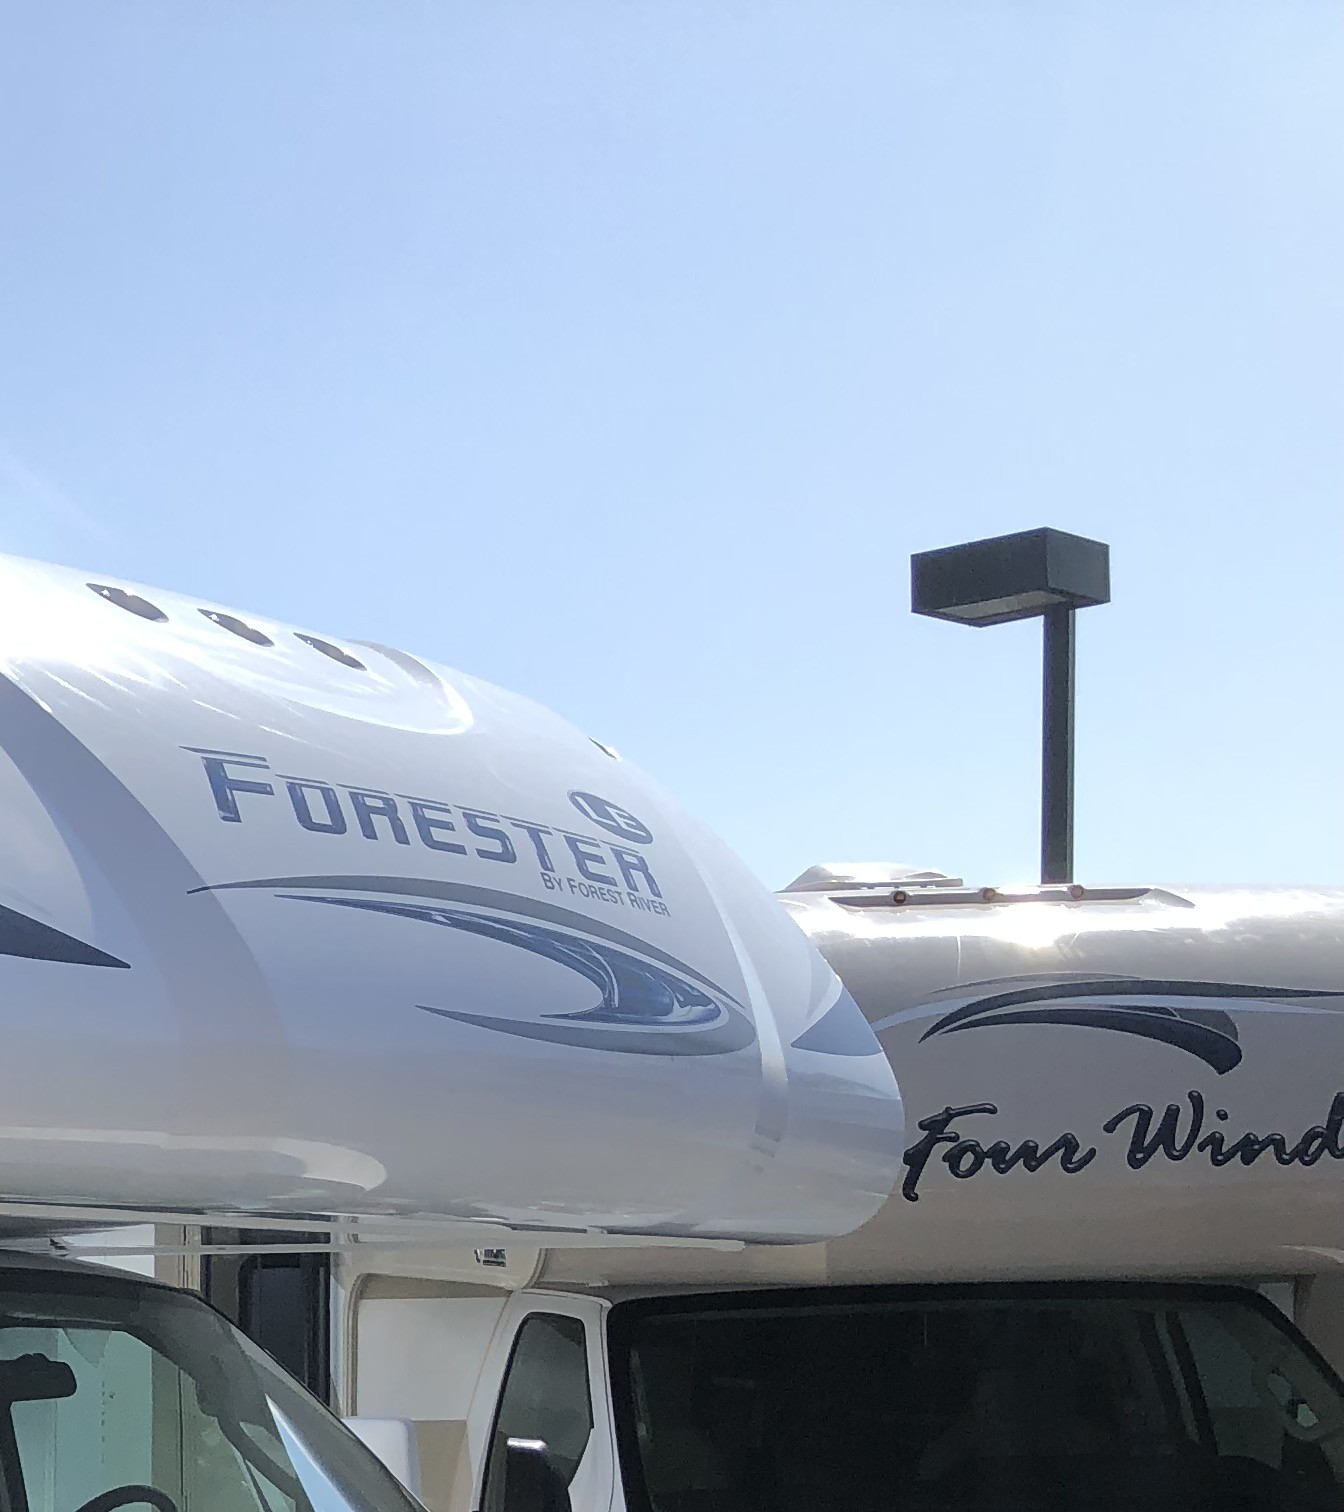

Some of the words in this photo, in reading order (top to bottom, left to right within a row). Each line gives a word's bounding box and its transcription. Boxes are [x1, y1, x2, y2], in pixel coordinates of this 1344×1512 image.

[179, 745, 663, 900] FORESTER
[574, 795, 647, 837] LE
[540, 871, 564, 892] BY
[566, 877, 625, 906] FOREST
[627, 891, 672, 918] RIVER
[902, 1103, 1097, 1202] Four
